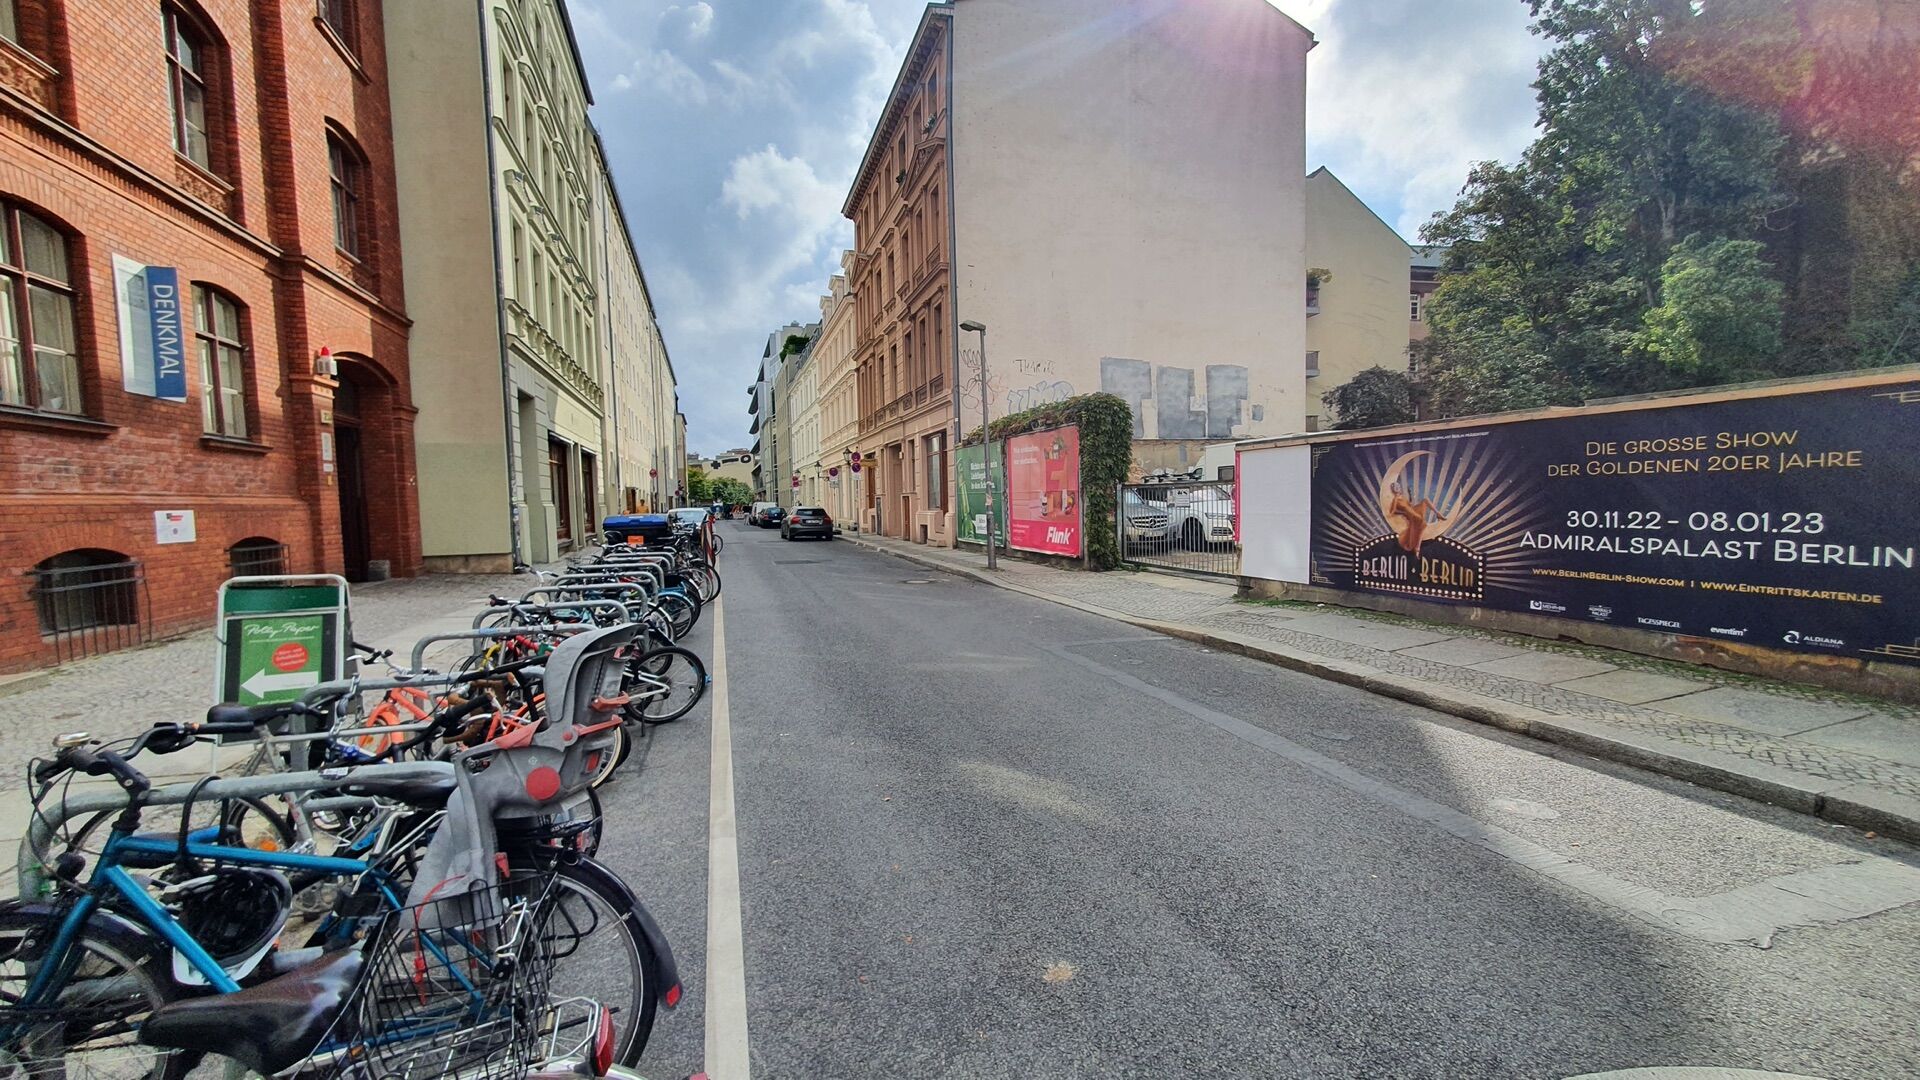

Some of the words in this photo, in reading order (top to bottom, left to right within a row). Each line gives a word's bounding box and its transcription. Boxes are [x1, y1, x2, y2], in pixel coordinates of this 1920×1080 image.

[153, 284, 180, 379] DENKMAL
[1586, 441, 1617, 456] DIE
[1624, 436, 1708, 454] GROSSE
[1715, 430, 1799, 449] SHOW
[1547, 463, 1580, 477] DER
[1586, 458, 1700, 476] GOLDENEN
[1707, 455, 1771, 473] 20ER
[1778, 450, 1863, 474] JAHRE
[1566, 510, 1662, 530] 30.11.22
[1688, 511, 1825, 534] 08.01.23
[1519, 531, 1763, 560] ADMIRALSPALAST
[1774, 539, 1914, 568] BERLIN
[1361, 555, 1407, 580] BERLIN
[1420, 556, 1474, 587] BERLIN
[1700, 581, 1883, 604] WWW.EINTRITTSKARTEN.DE
[1710, 626, 1744, 637] eventim
[1803, 635, 1844, 645] ALDIANA
